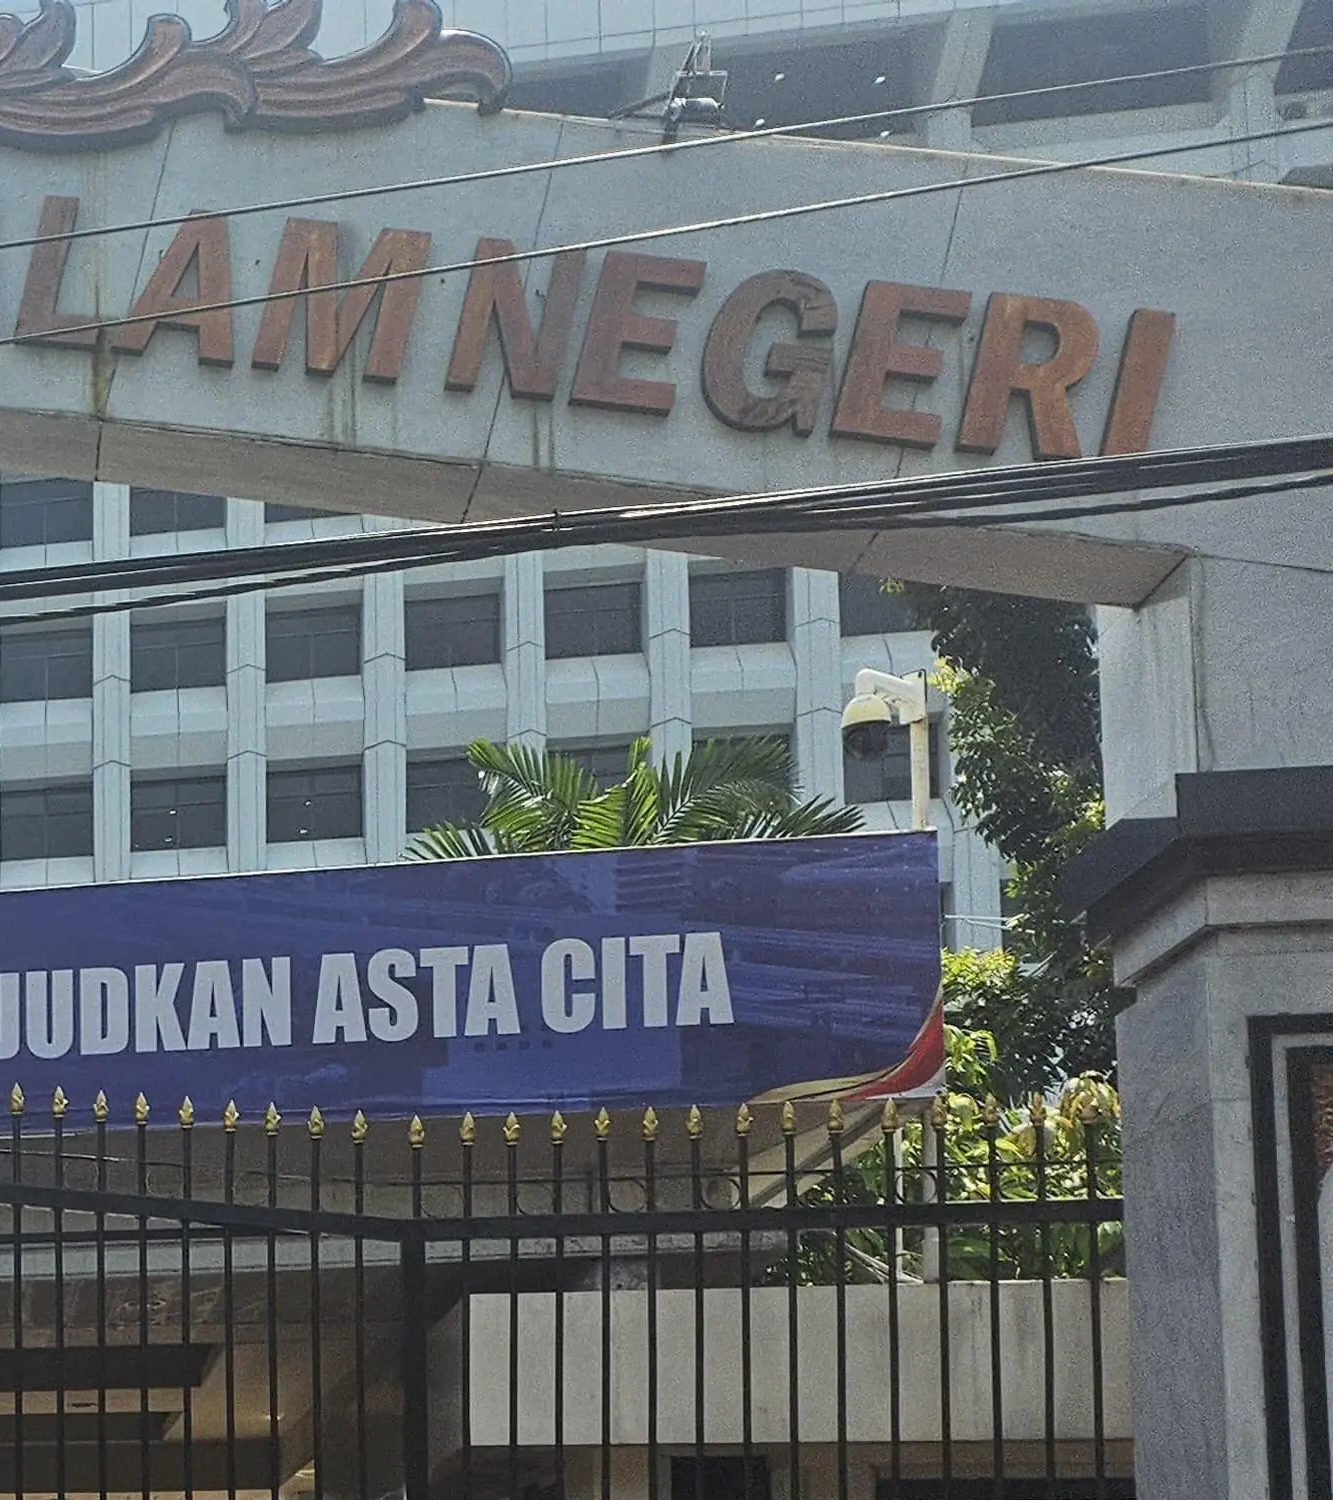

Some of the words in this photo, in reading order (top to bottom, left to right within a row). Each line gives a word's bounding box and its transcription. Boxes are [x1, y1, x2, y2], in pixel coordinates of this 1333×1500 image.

[443, 233, 1176, 461] NEGERI
[312, 943, 522, 1045] ASTA
[540, 931, 736, 1033] CITA
